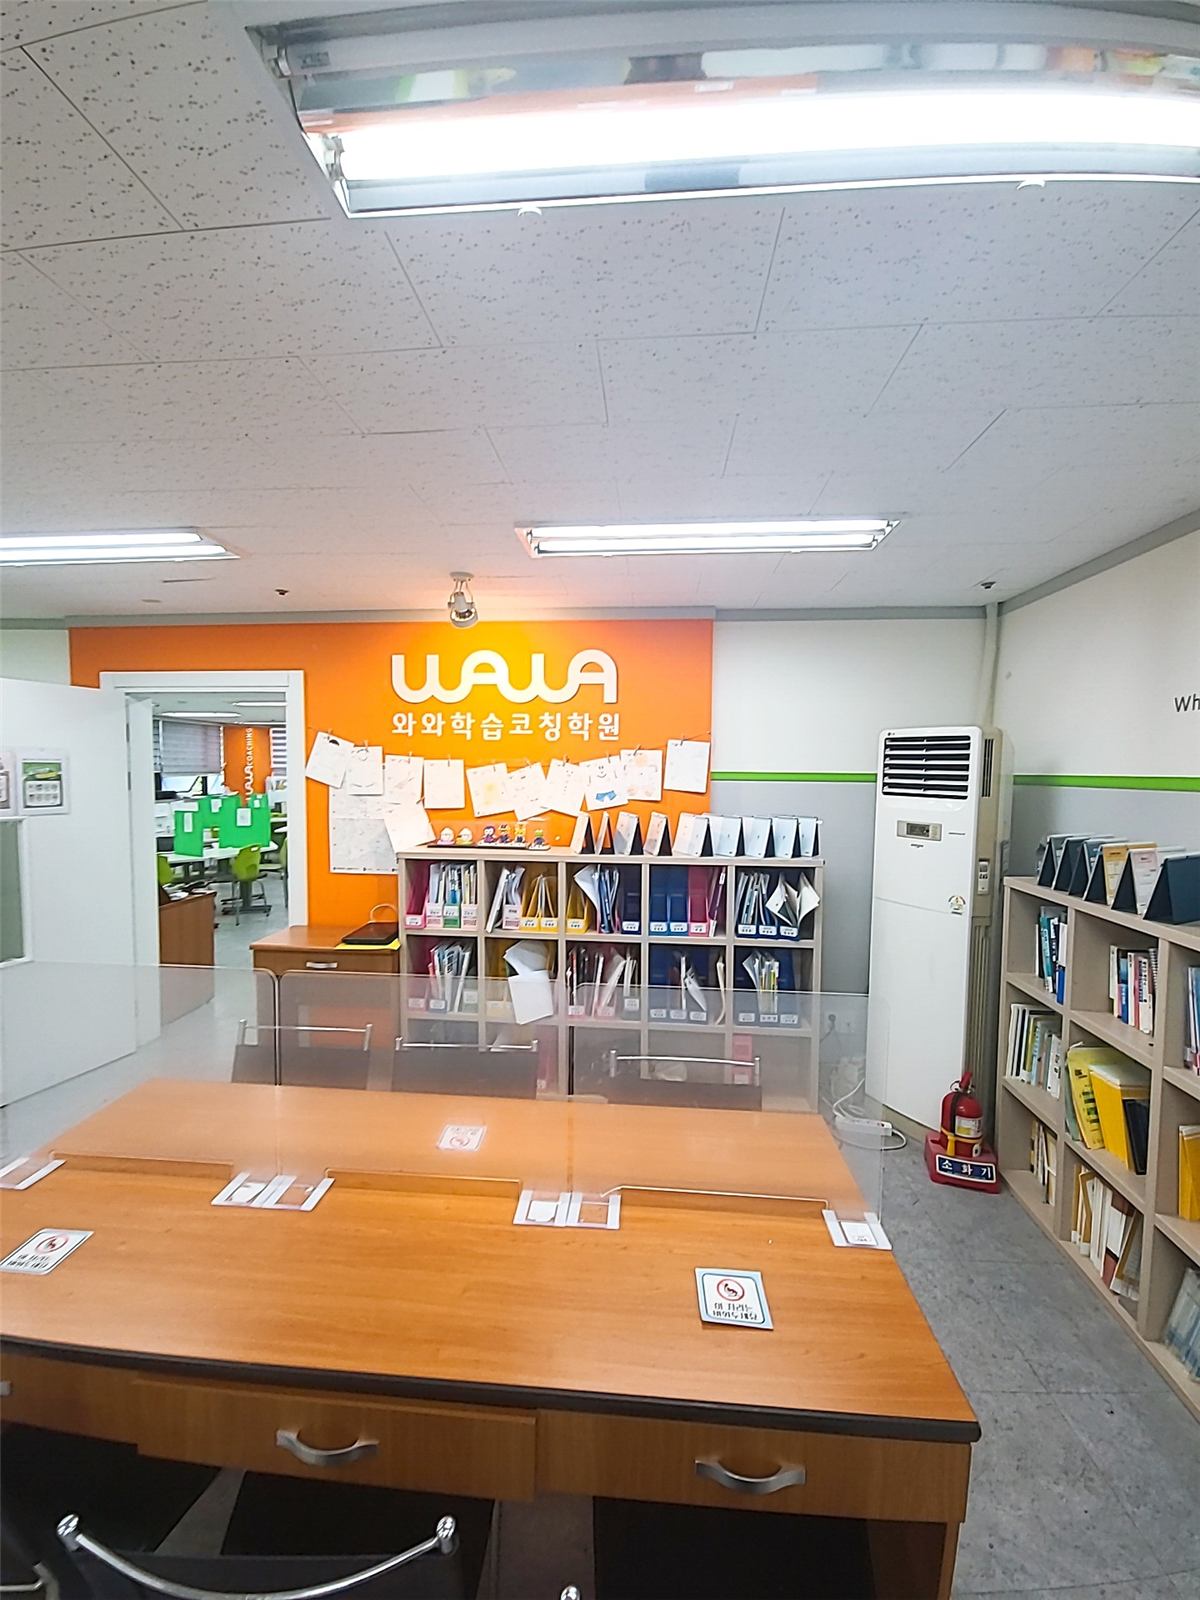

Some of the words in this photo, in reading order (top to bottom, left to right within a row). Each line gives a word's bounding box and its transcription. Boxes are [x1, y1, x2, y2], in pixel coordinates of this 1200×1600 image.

[391, 649, 618, 704] WAWA
[391, 711, 620, 741] 와와학습코칭학원
[941, 1159, 992, 1179] 소화기
